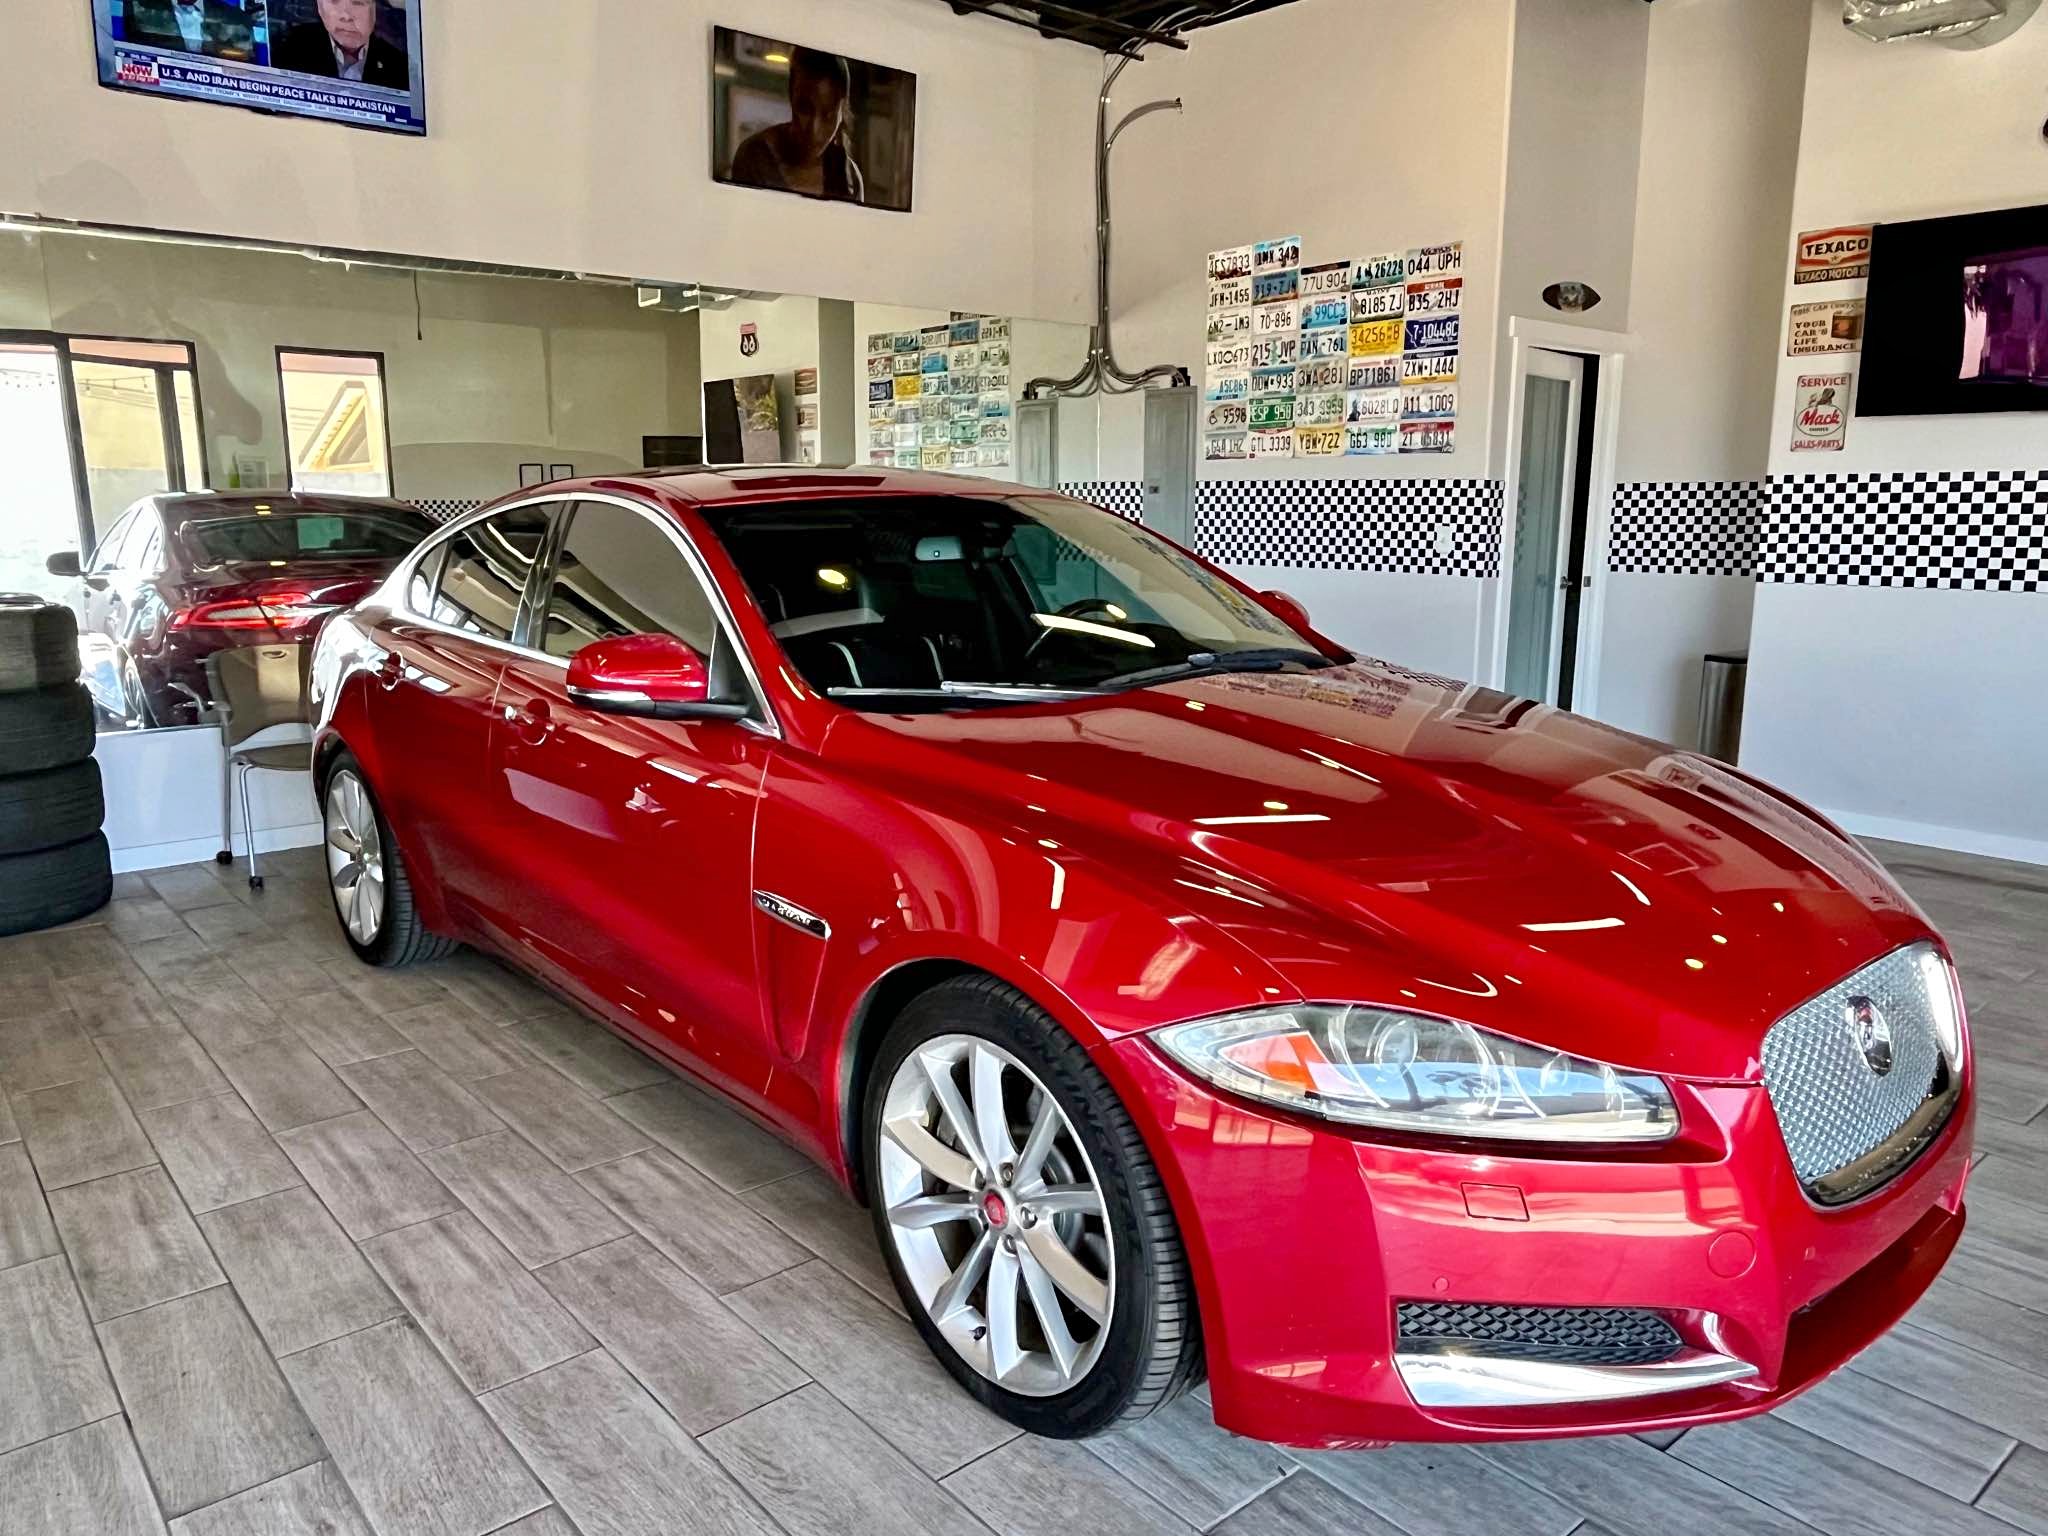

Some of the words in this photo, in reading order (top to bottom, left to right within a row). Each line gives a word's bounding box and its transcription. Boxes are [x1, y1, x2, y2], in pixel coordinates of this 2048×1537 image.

[122, 63, 152, 76] NOW
[162, 67, 184, 79] U.S.
[186, 71, 210, 84] AND
[212, 75, 238, 88] IRAN
[239, 80, 271, 93] BEGIN
[272, 86, 304, 99] PEACE
[306, 91, 335, 104] TALKS
[337, 96, 348, 106] IN
[350, 98, 396, 114] PAKISTAN
[1805, 238, 1869, 257] TEXACO
[1438, 251, 1461, 271] UPH
[1326, 271, 1347, 288] 904
[1796, 269, 1828, 283] TEXACO
[1828, 267, 1858, 280] MOTOR
[1360, 295, 1385, 315] 8185
[1389, 293, 1402, 311] ZJ
[1409, 292, 1430, 312] B35
[1438, 289, 1459, 309] 2HJ
[1795, 320, 1826, 329] YOUR
[1793, 343, 1857, 354] INSURANCE
[1794, 337, 1818, 346] LIFE
[1252, 342, 1271, 362] 215
[1801, 376, 1847, 388] SERVICE
[1800, 408, 1840, 426] Mack
